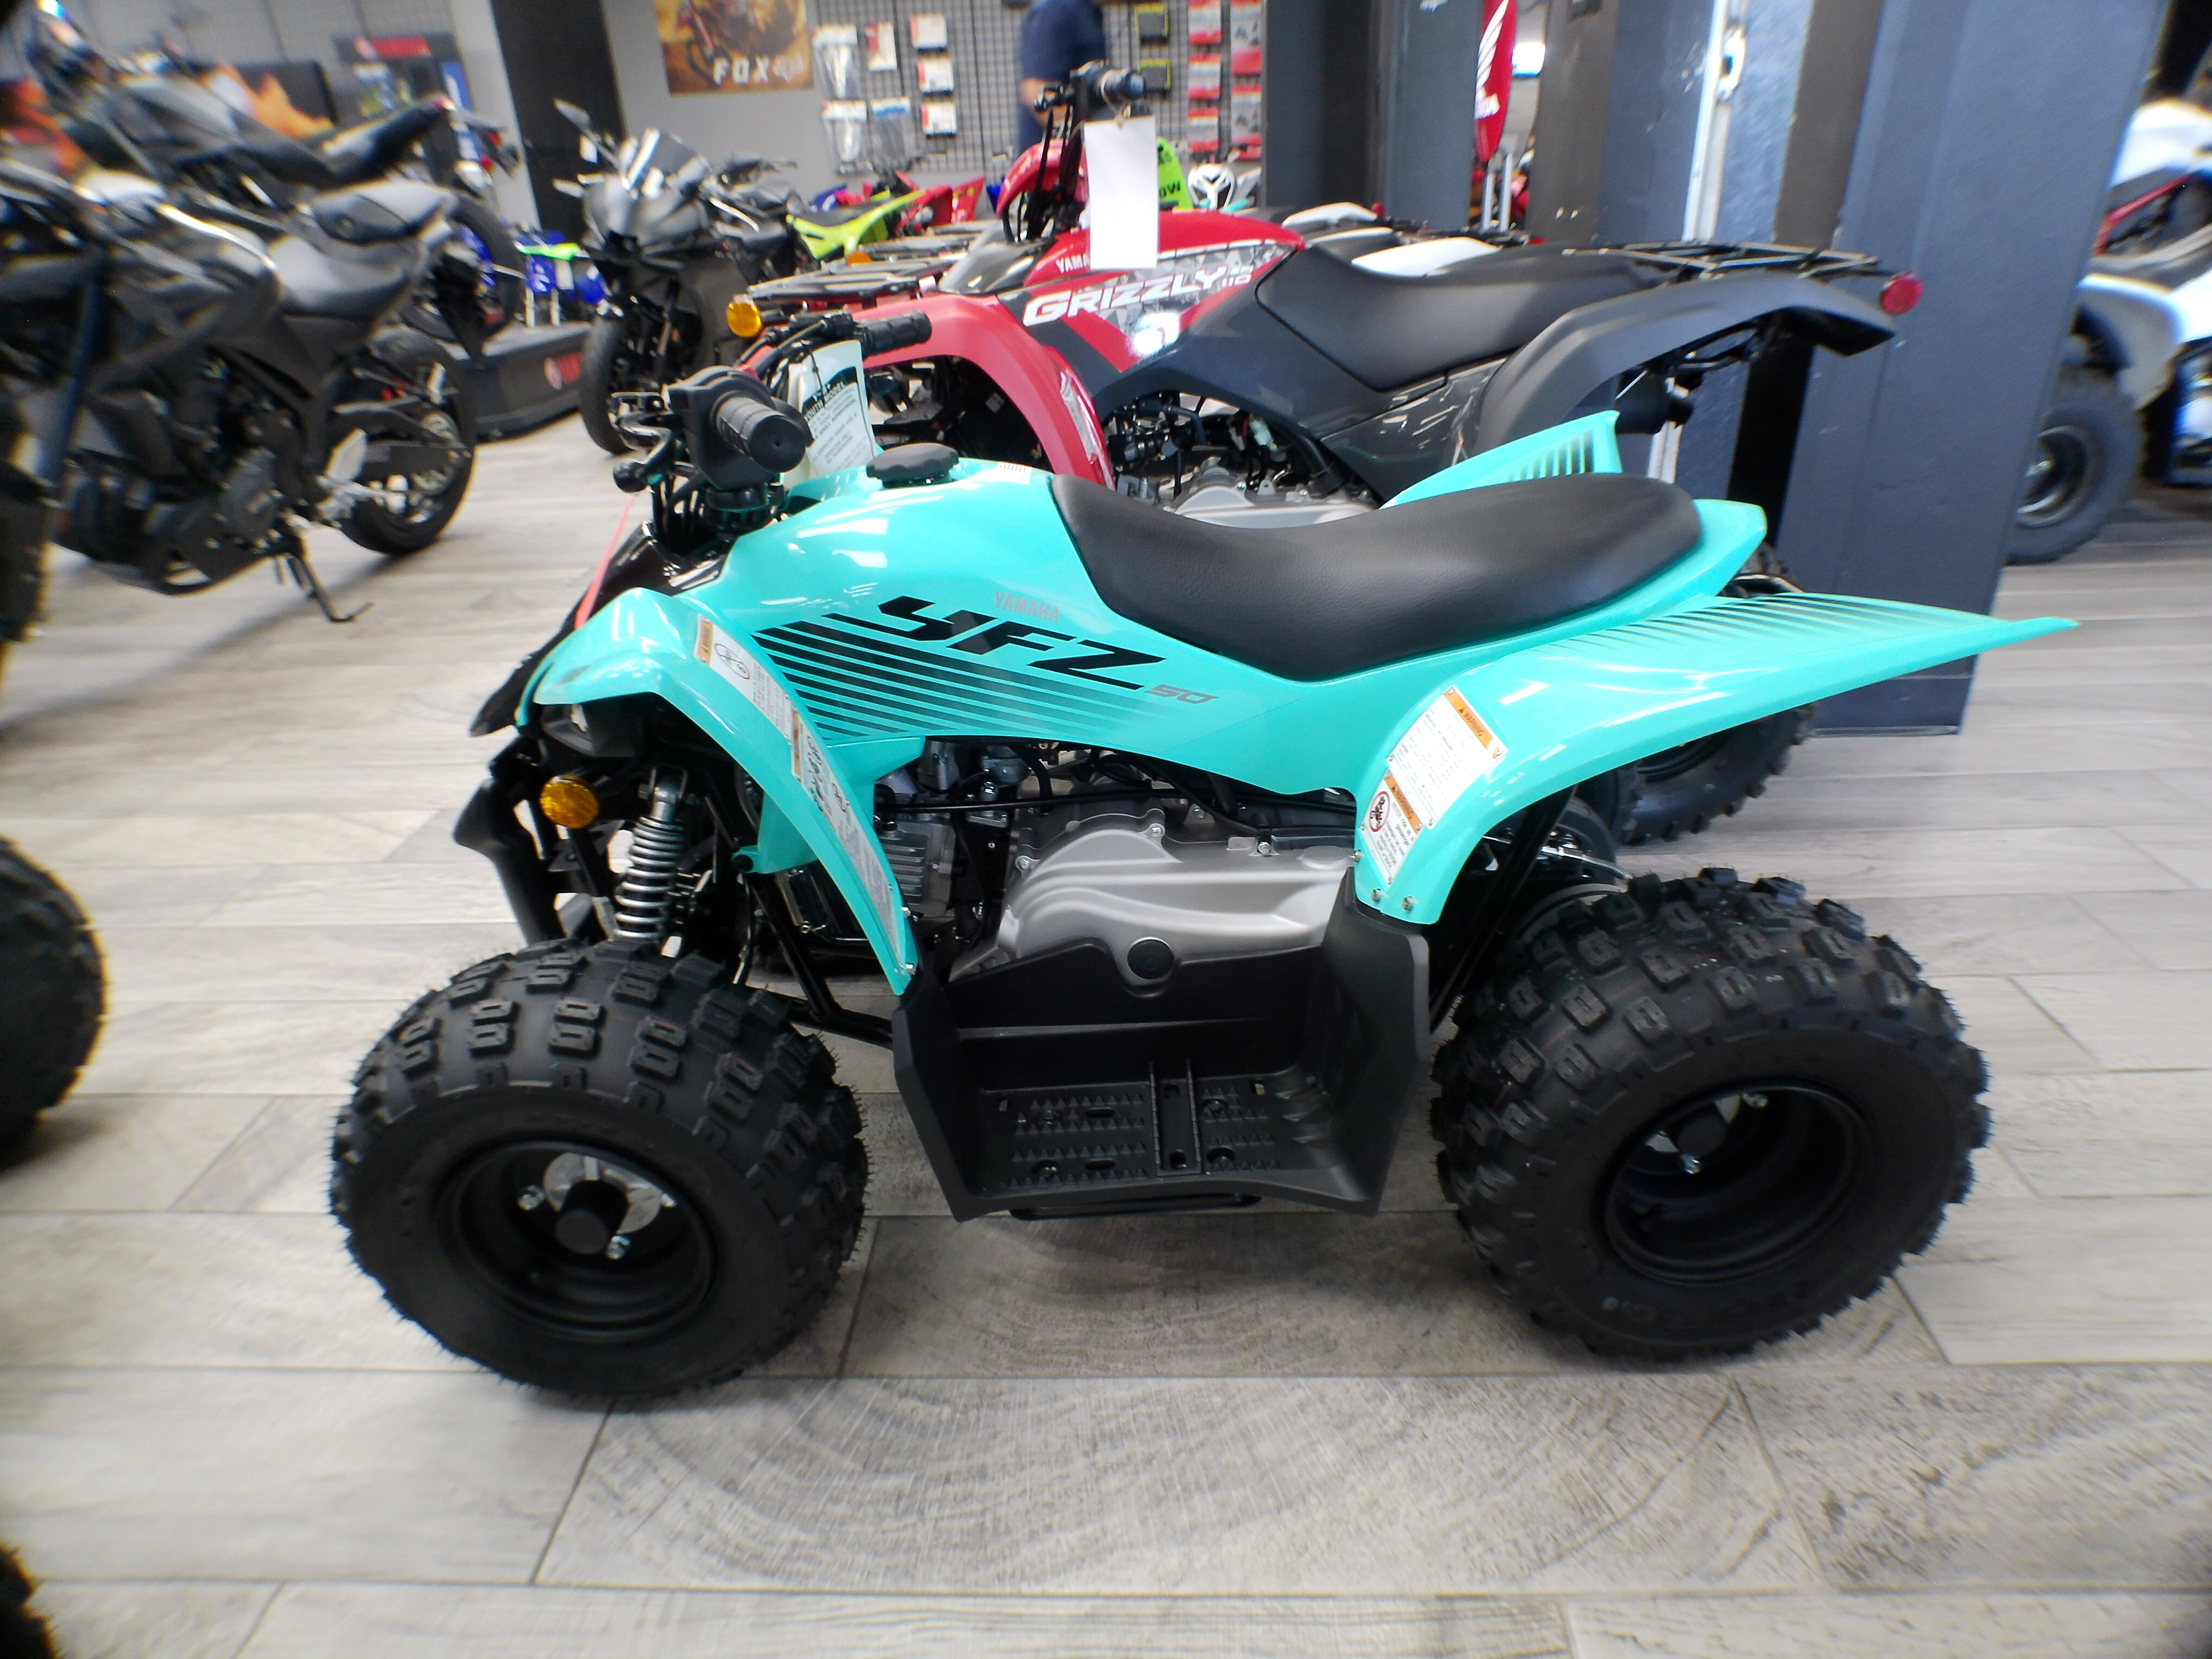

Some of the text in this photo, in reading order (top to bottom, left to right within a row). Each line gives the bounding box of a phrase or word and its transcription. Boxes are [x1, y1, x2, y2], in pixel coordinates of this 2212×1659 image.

[713, 55, 769, 86] FOX
[1055, 253, 1091, 273] YAMA
[1023, 265, 1228, 327] GRIZZLY
[994, 590, 1060, 623] YAMAHA
[877, 595, 1220, 705] YFZ 50
